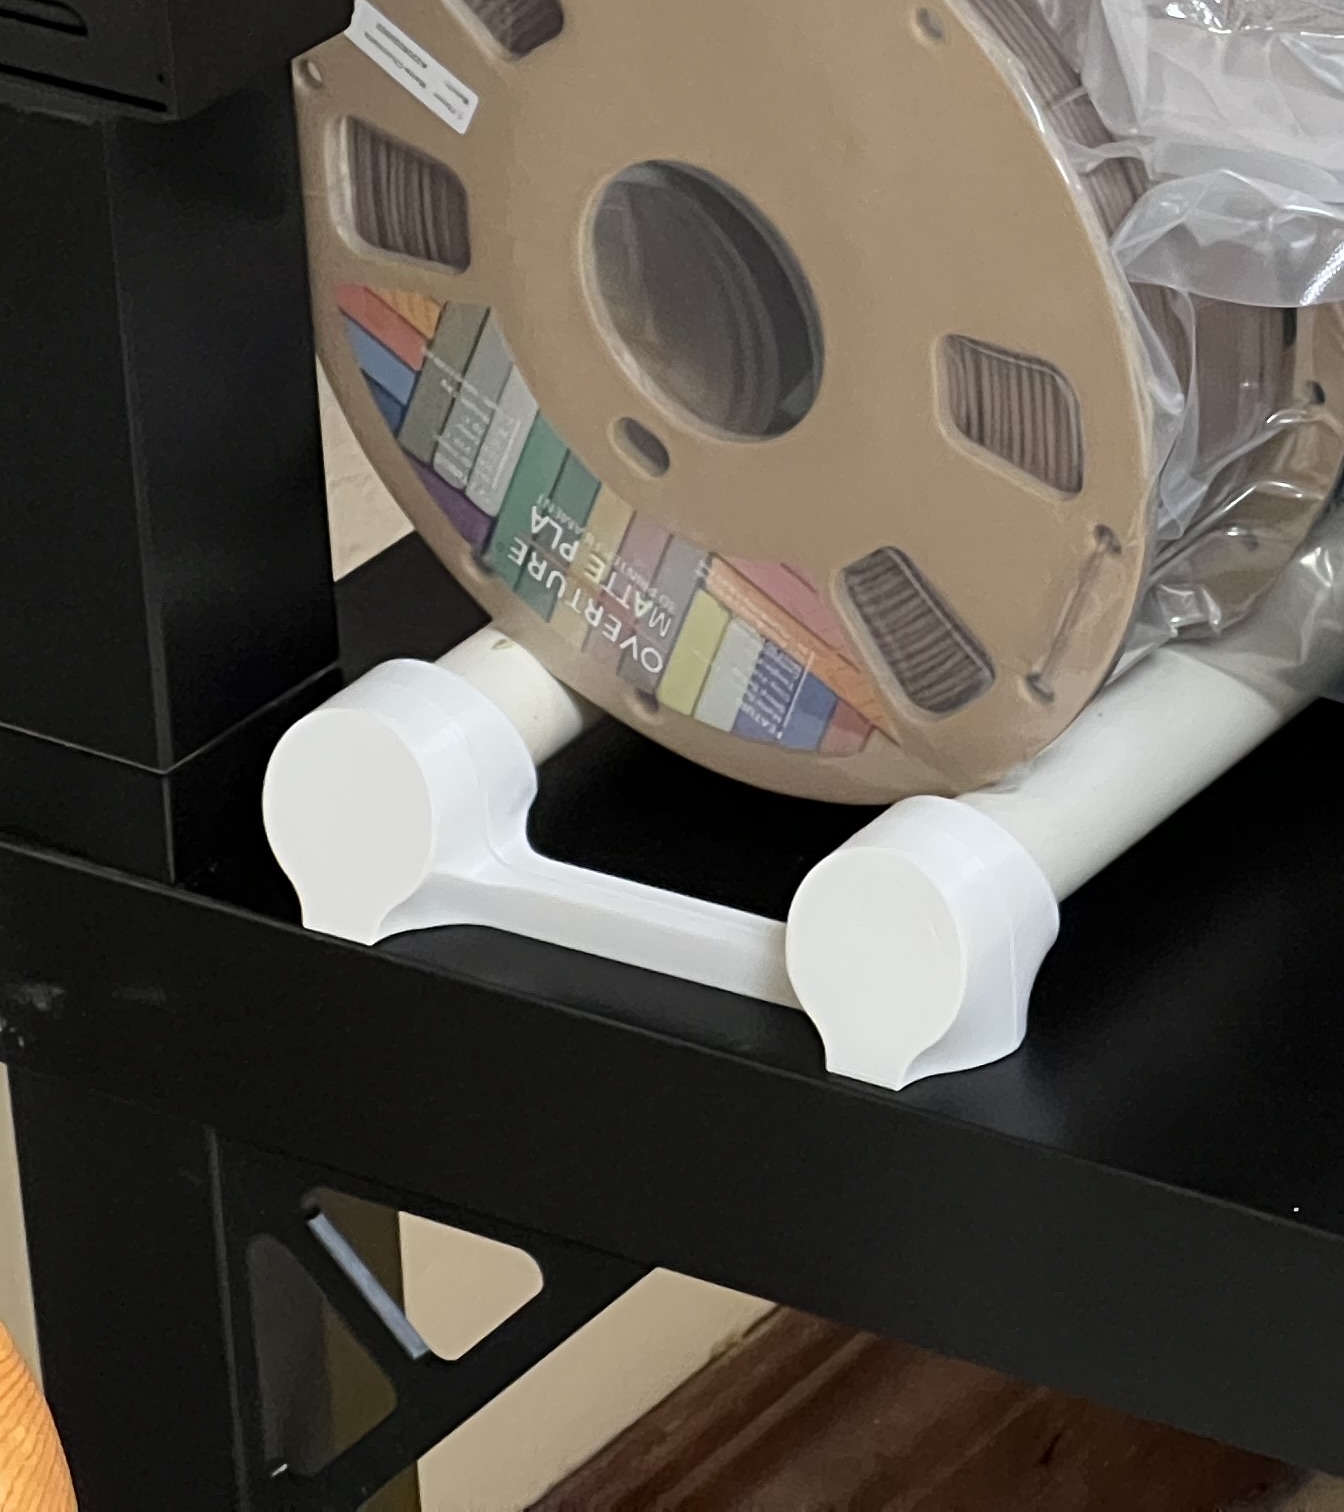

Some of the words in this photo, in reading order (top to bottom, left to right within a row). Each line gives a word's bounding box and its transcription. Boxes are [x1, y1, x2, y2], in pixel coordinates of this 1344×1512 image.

[530, 505, 580, 563] PLA
[507, 536, 664, 674] OVERTURE
[583, 550, 673, 638] MATTE
